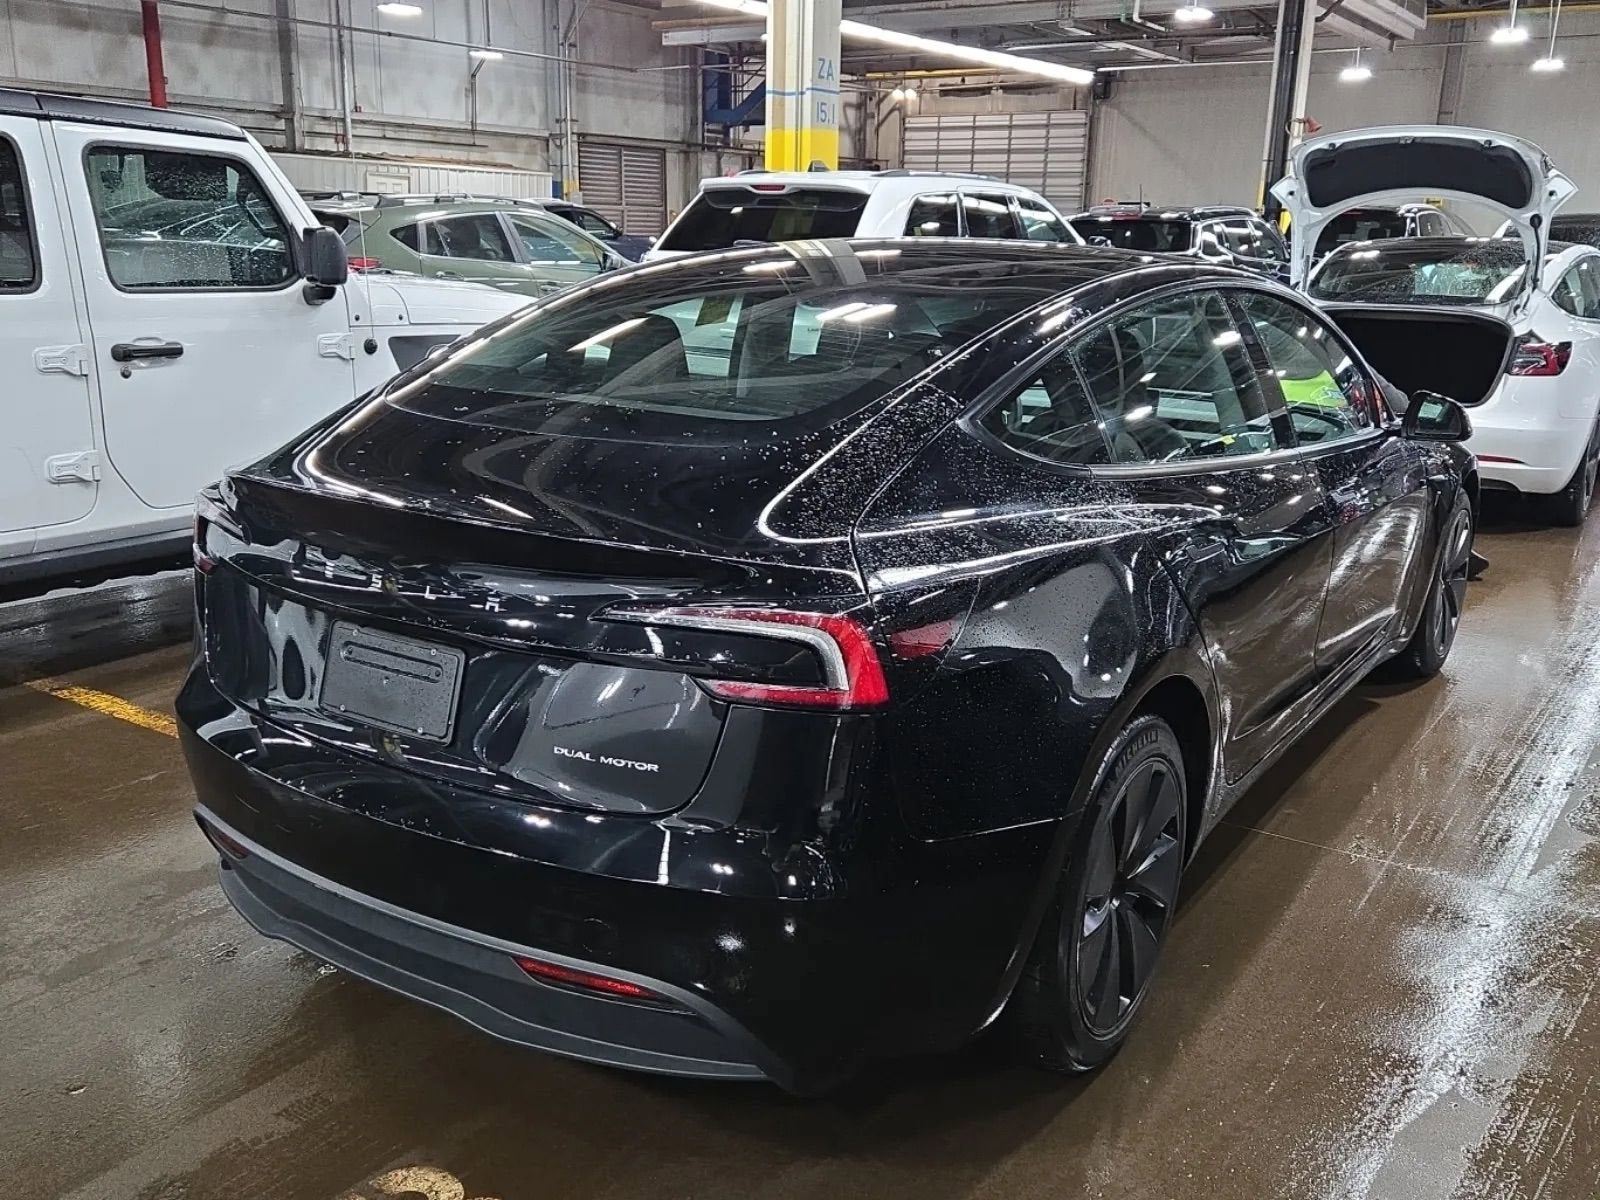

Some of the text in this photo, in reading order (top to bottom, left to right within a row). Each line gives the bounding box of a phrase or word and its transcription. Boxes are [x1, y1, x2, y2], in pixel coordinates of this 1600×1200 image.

[817, 57, 835, 81] ZA
[553, 746, 660, 772] DUAL MOTOR
